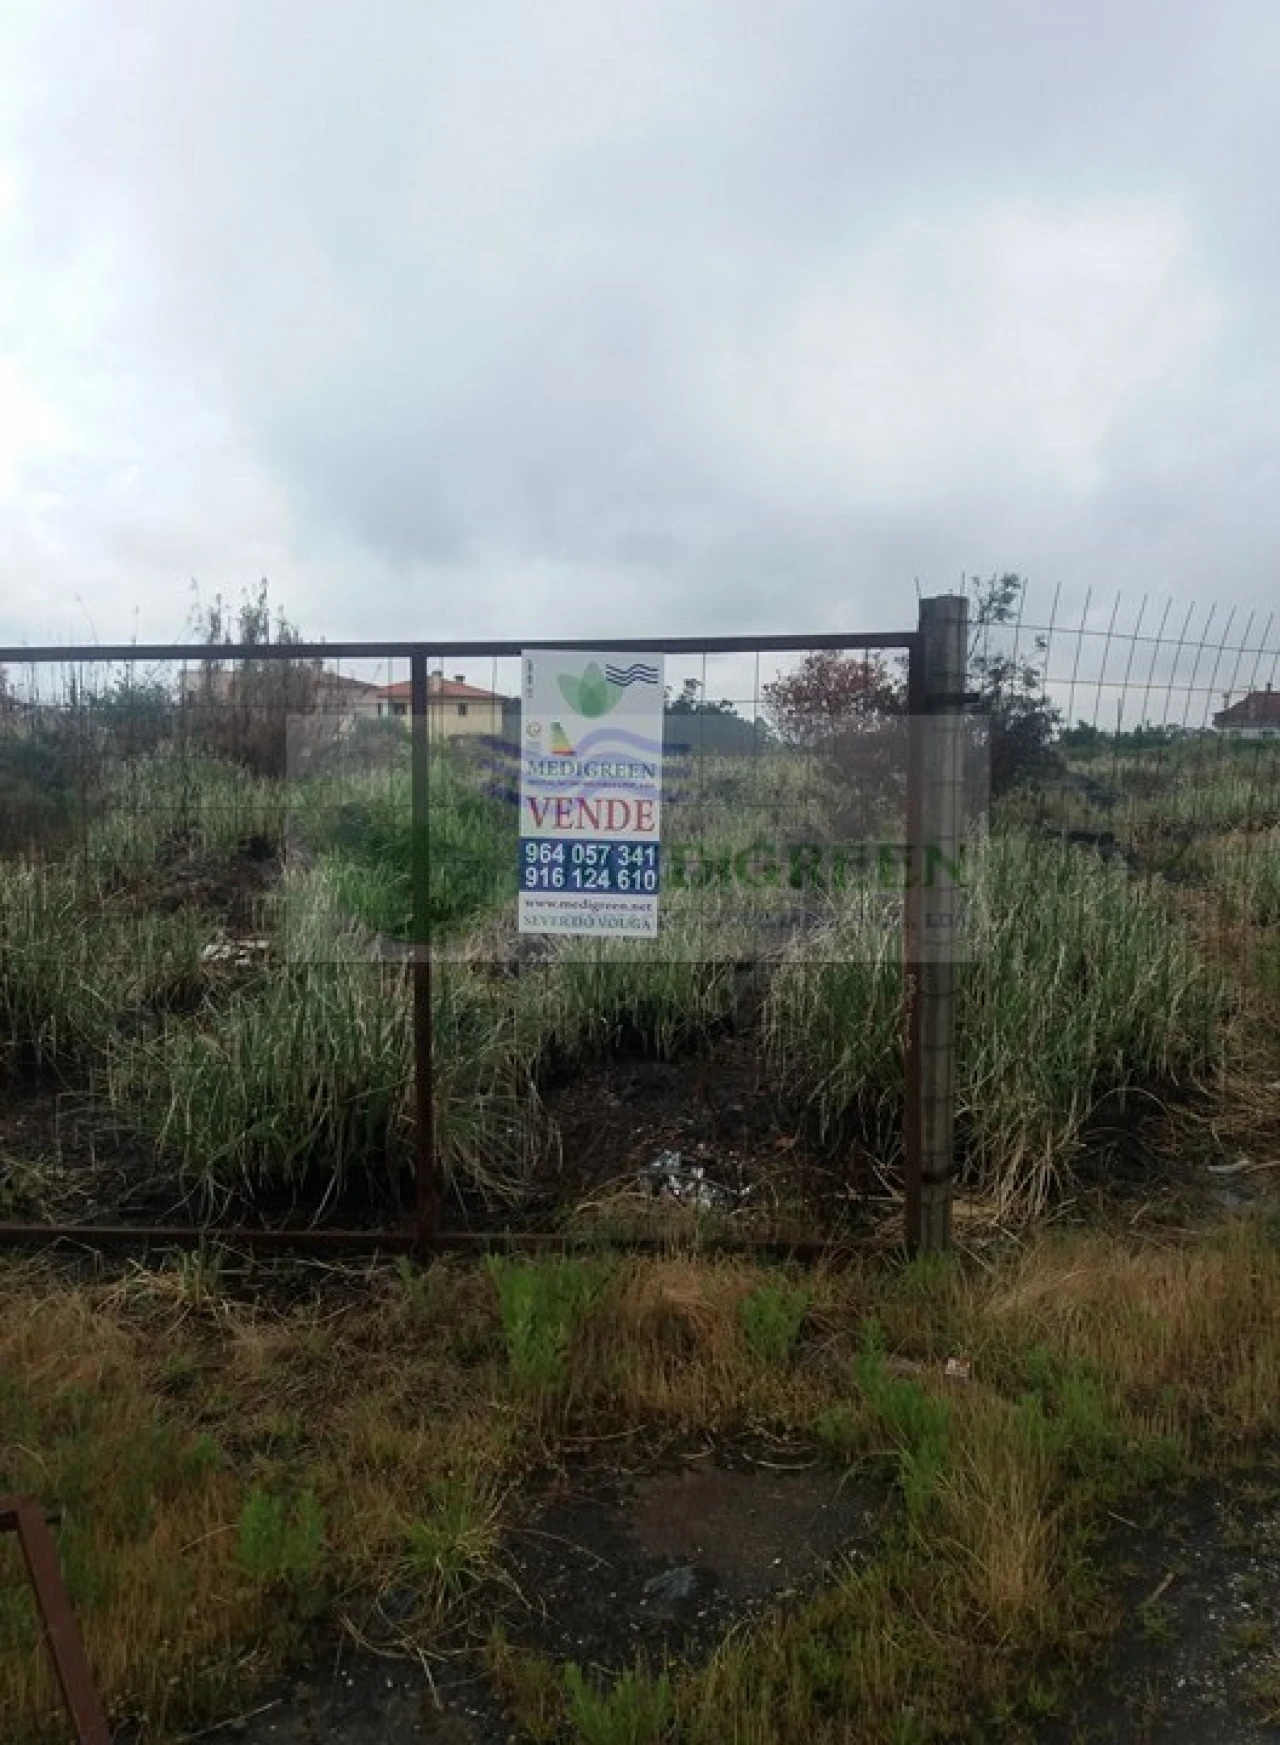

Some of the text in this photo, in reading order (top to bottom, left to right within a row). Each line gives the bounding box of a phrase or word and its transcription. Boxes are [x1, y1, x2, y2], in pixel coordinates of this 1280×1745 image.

[526, 760, 656, 779] MEDIGREEN
[526, 796, 654, 832] VENDE
[525, 843, 656, 867] 964 057 341
[525, 867, 656, 890] 916 124 610
[525, 899, 653, 912] www.medigreen.net
[598, 916, 653, 931] VOUGA
